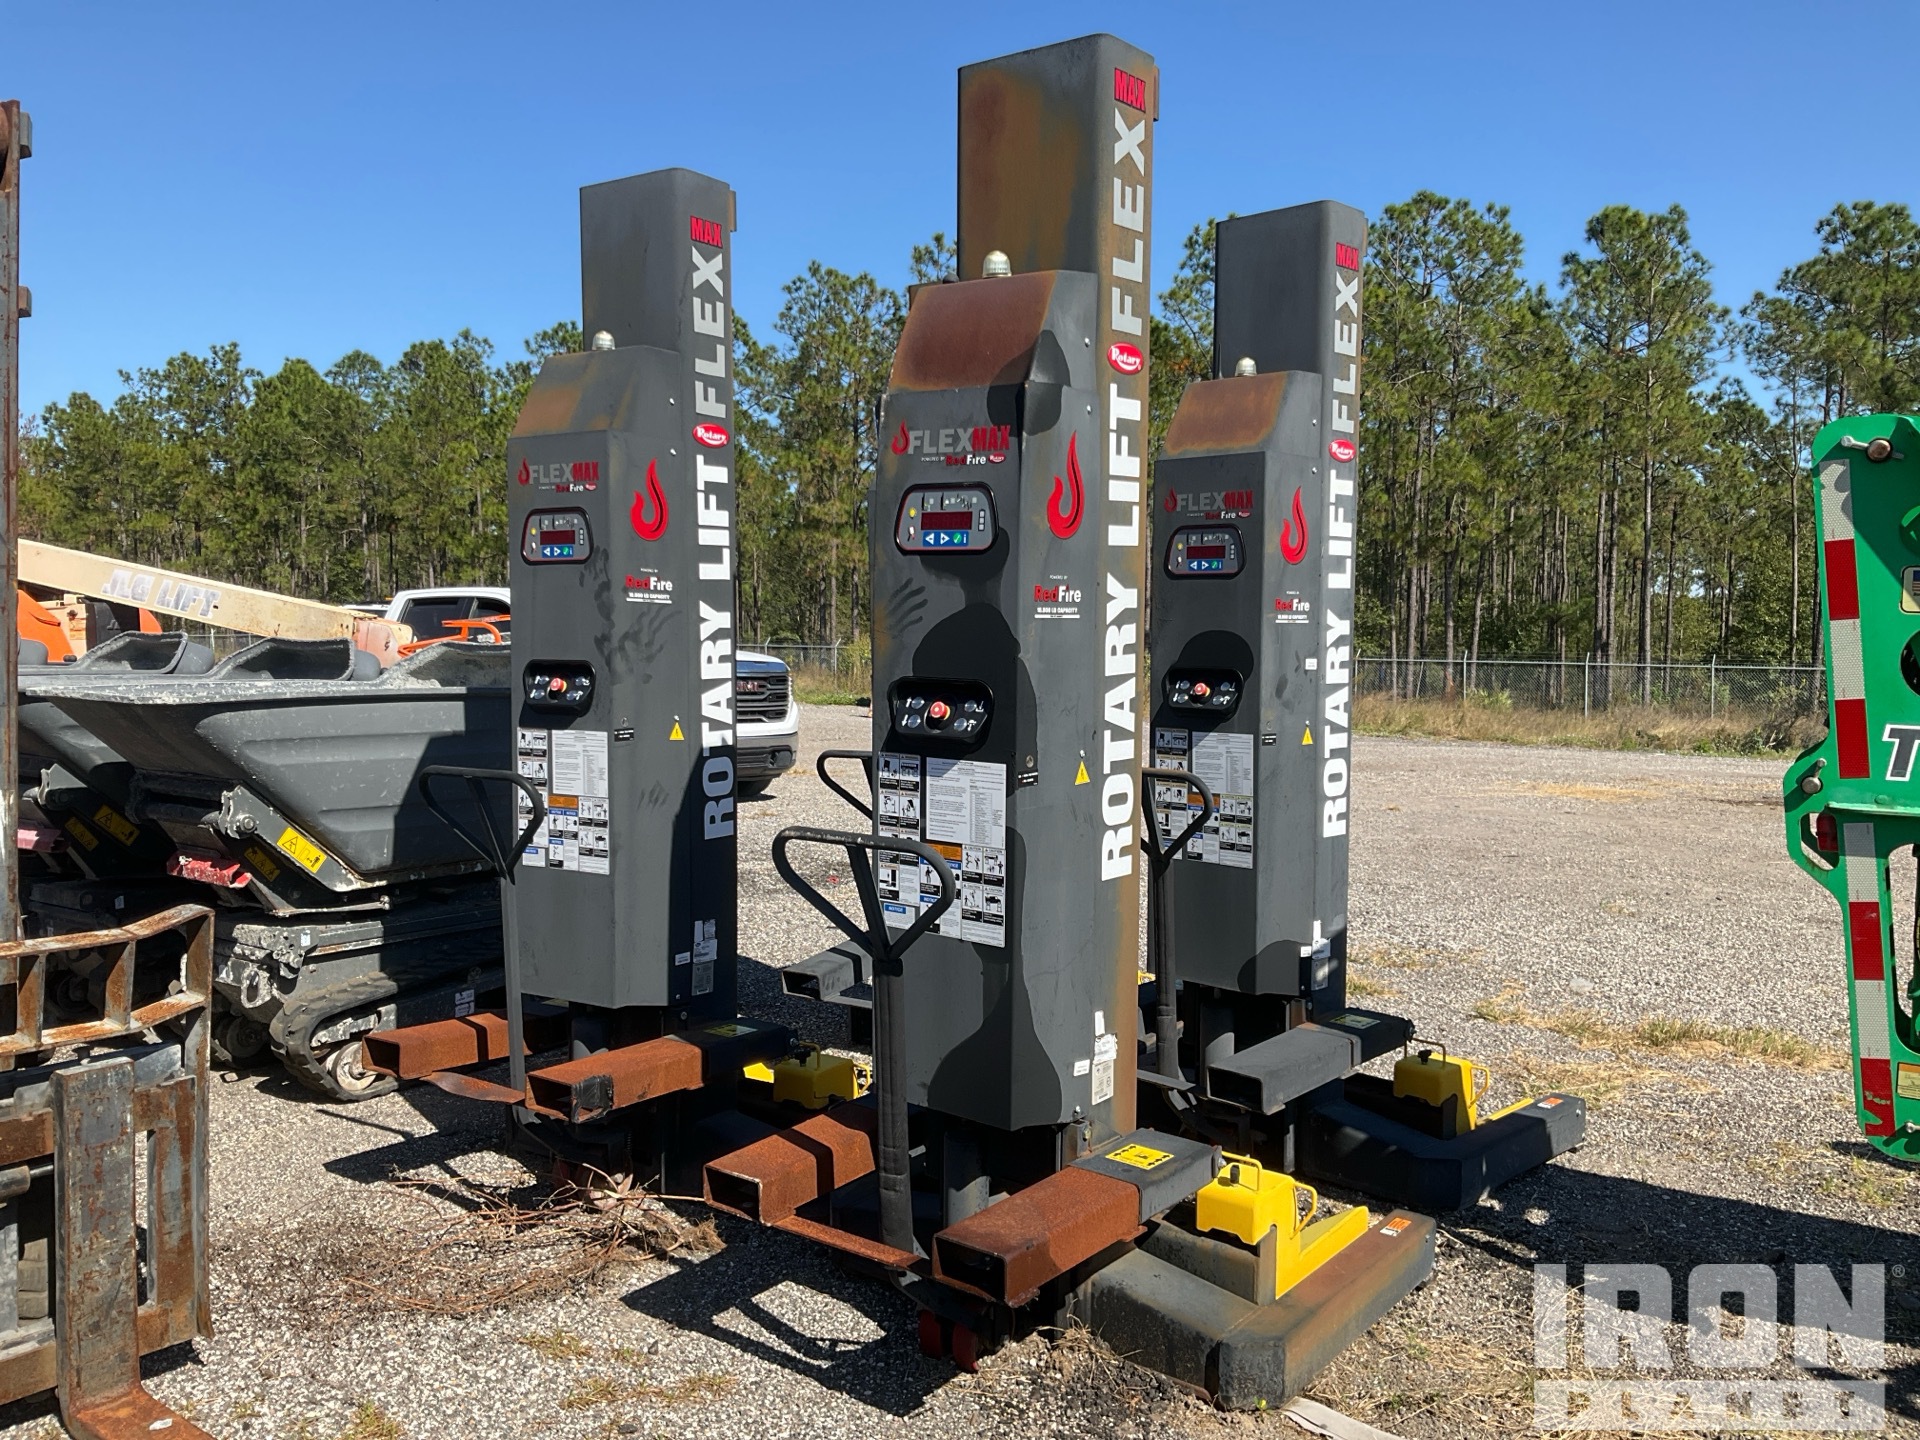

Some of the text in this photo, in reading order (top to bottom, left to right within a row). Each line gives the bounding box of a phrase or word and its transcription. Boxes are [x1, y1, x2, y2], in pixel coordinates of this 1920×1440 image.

[1114, 68, 1146, 113] MAX
[690, 215, 723, 248] MAX
[1112, 107, 1145, 336] FLEX
[1336, 242, 1359, 272] MAX
[692, 246, 727, 419] FLEX
[1111, 345, 1141, 370] Rotary
[1332, 271, 1358, 433] FLEX
[100, 568, 222, 619] JLG LIFT
[625, 575, 672, 591] RedFire
[1034, 585, 1081, 602] RedFire
[696, 455, 734, 840] ROTARY LIFT
[1102, 383, 1141, 881] ROTARY LIFT
[1323, 469, 1353, 838] ROTARY LIFT
